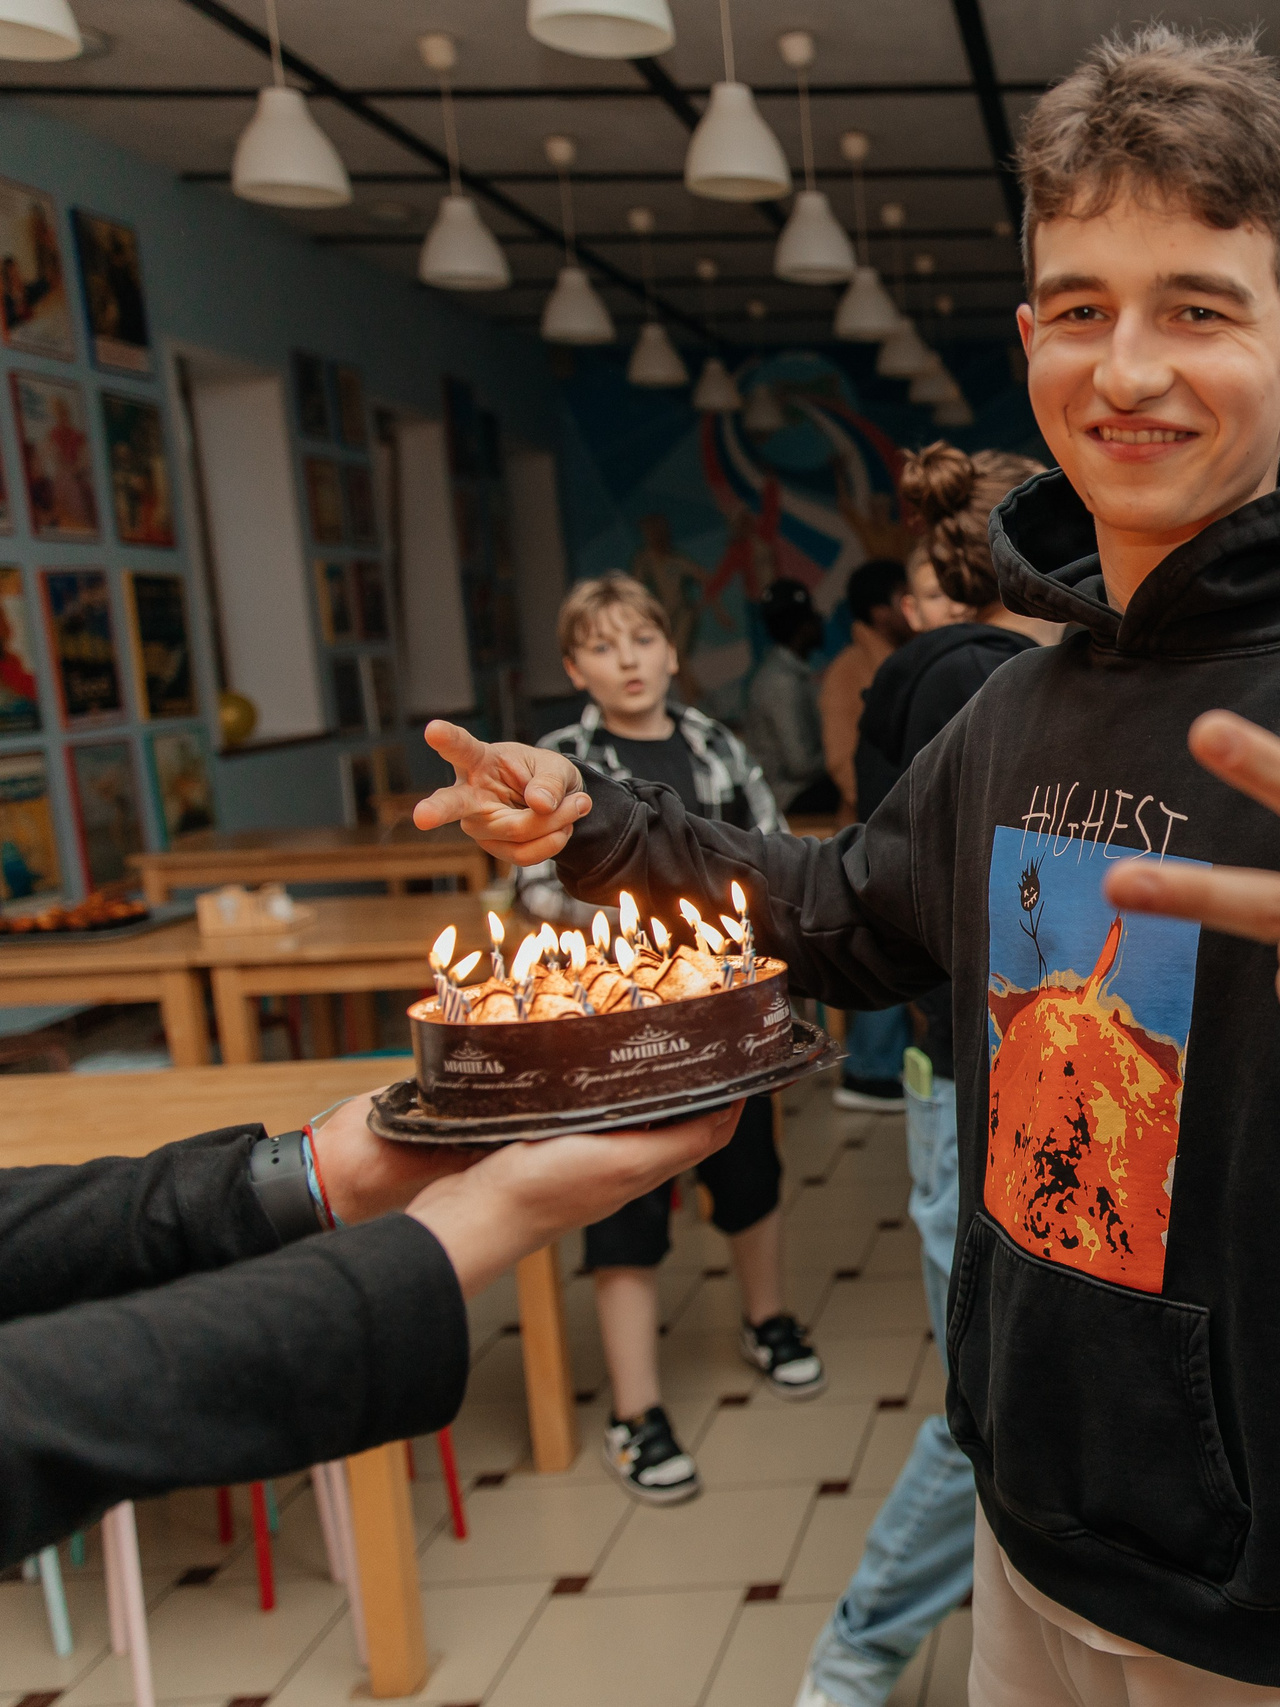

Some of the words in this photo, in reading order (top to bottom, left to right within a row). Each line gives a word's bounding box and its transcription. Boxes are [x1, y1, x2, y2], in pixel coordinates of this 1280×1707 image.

[1020, 782, 1188, 866] HIGHEST
[609, 1036, 691, 1063] МИШЕЛЬ
[443, 1060, 505, 1074] МИШЕЛЬ
